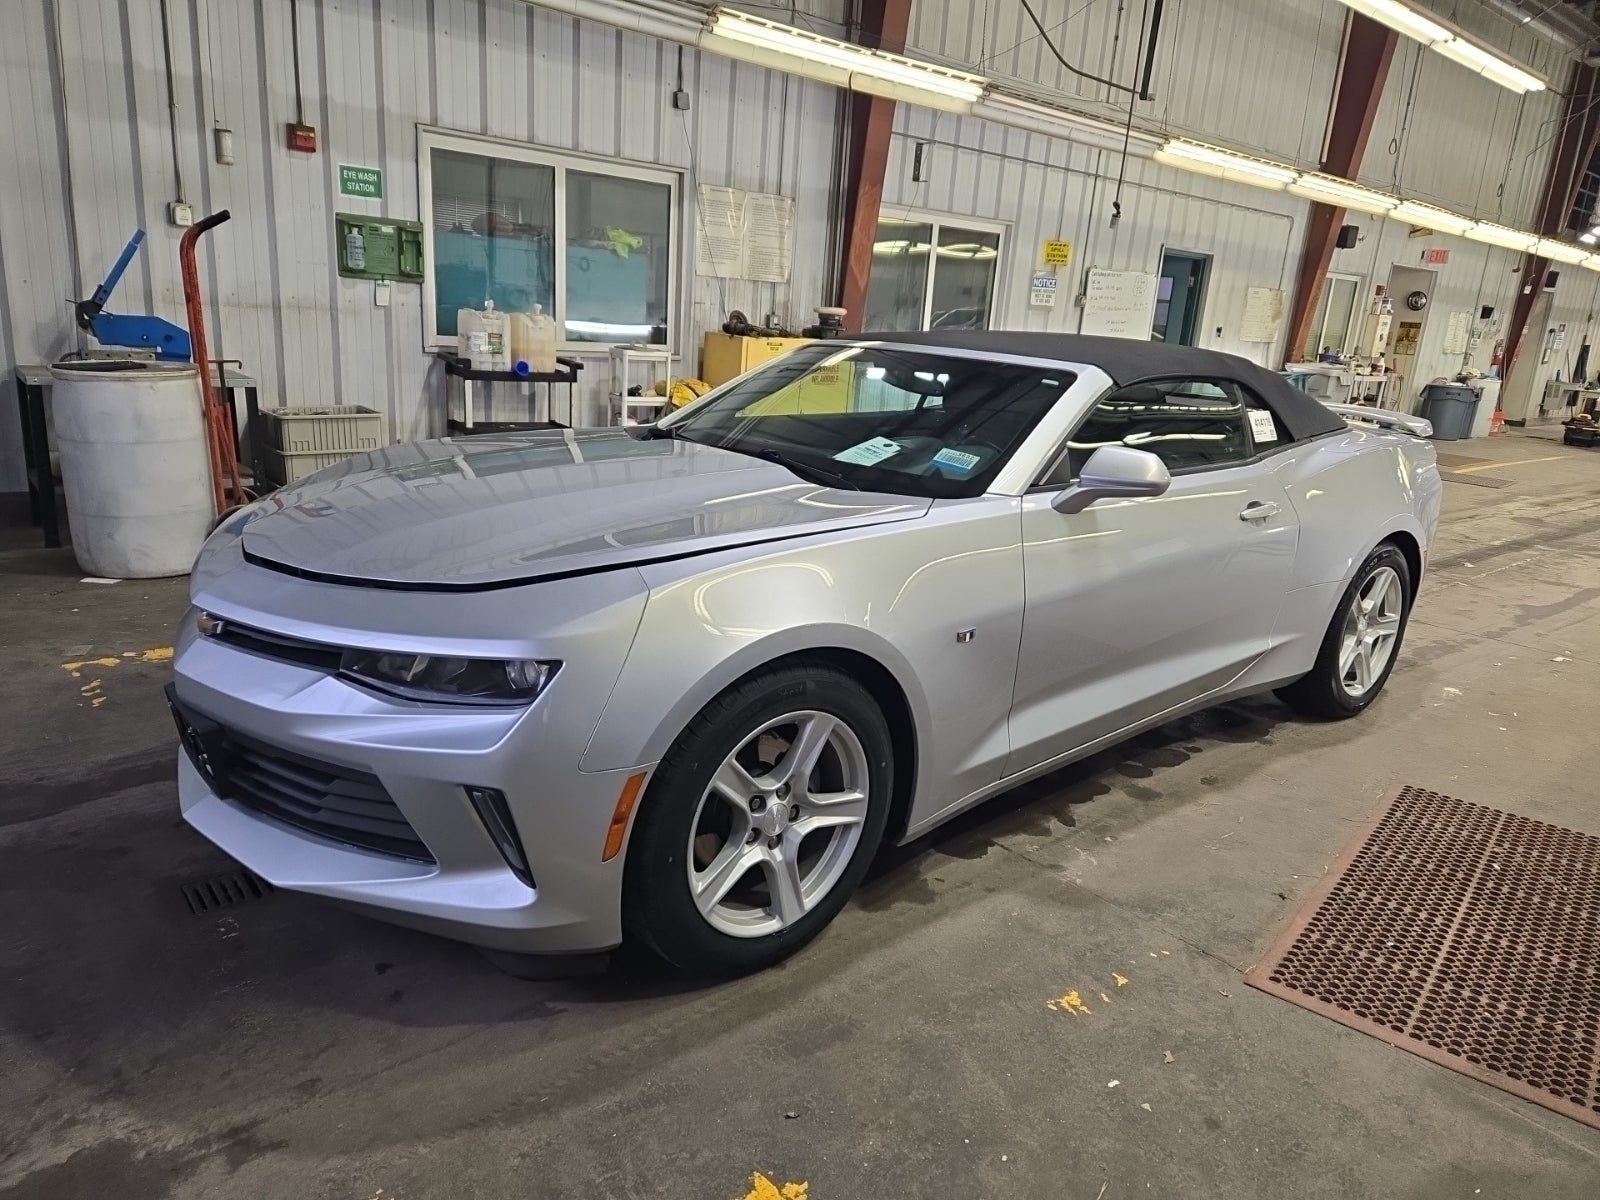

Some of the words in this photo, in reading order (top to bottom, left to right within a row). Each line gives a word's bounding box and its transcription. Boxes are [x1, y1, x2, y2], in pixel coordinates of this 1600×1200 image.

[344, 170, 356, 179] EYE
[358, 171, 377, 182] WASH
[347, 182, 375, 192] STATION
[1033, 279, 1056, 288] NOTICE
